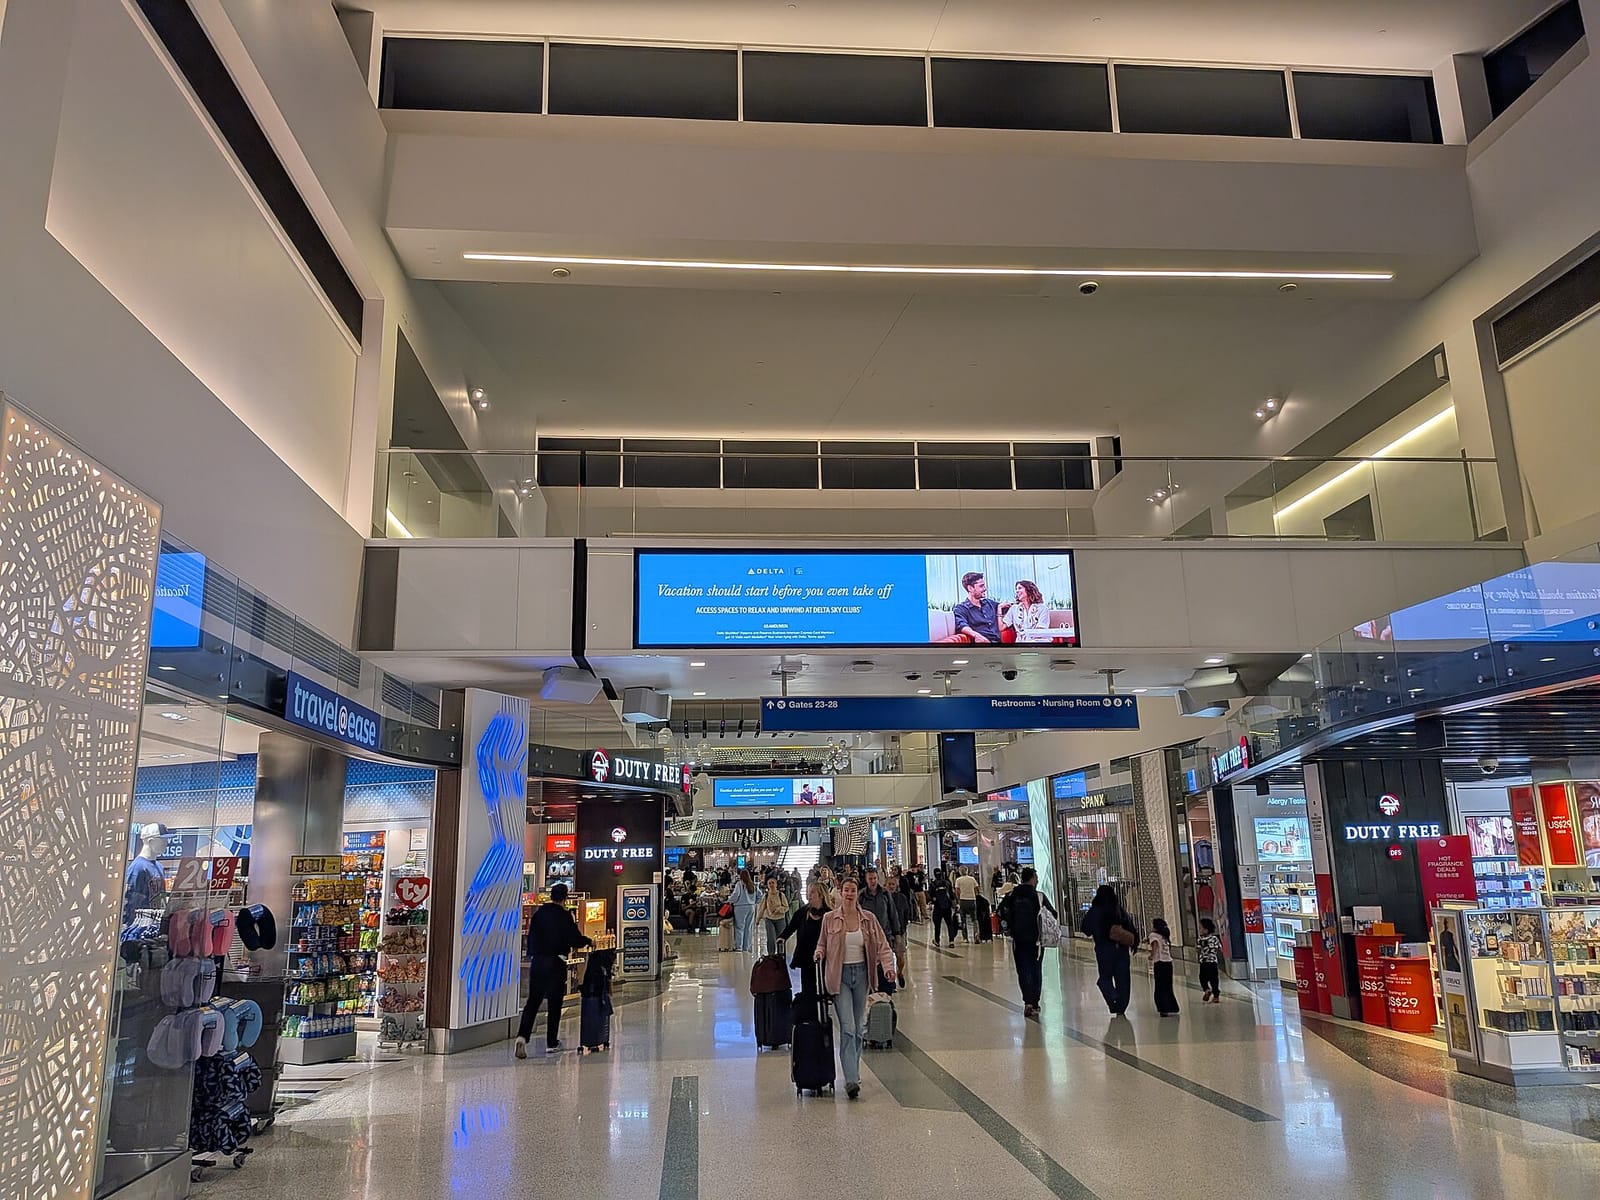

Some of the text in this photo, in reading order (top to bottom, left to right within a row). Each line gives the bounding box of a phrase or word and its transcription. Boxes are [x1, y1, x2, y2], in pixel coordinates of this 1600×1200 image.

[657, 583, 894, 600] Vacation should start before you even take off
[695, 606, 717, 615] ACCESS
[717, 606, 739, 615] SPACES
[739, 606, 748, 614] TO
[748, 606, 767, 614] RELAX
[767, 606, 779, 614] AND
[780, 606, 805, 614] UNWIND
[805, 606, 813, 614] AT
[813, 606, 830, 614] DELTA
[830, 606, 842, 614] SKY
[789, 700, 838, 709] Gates 23-28
[991, 699, 1101, 709] Restrooms Nursing Room
[294, 681, 377, 747] travel@ease
[615, 758, 650, 780] DUTY
[654, 763, 681, 784] FREE
[1081, 794, 1104, 809] SPANX
[1346, 824, 1441, 840] DUTY FREE
[584, 847, 653, 859] DUTY FREE
[209, 878, 228, 889] OFF
[399, 879, 428, 902] ty
[628, 896, 645, 904] ZYN
